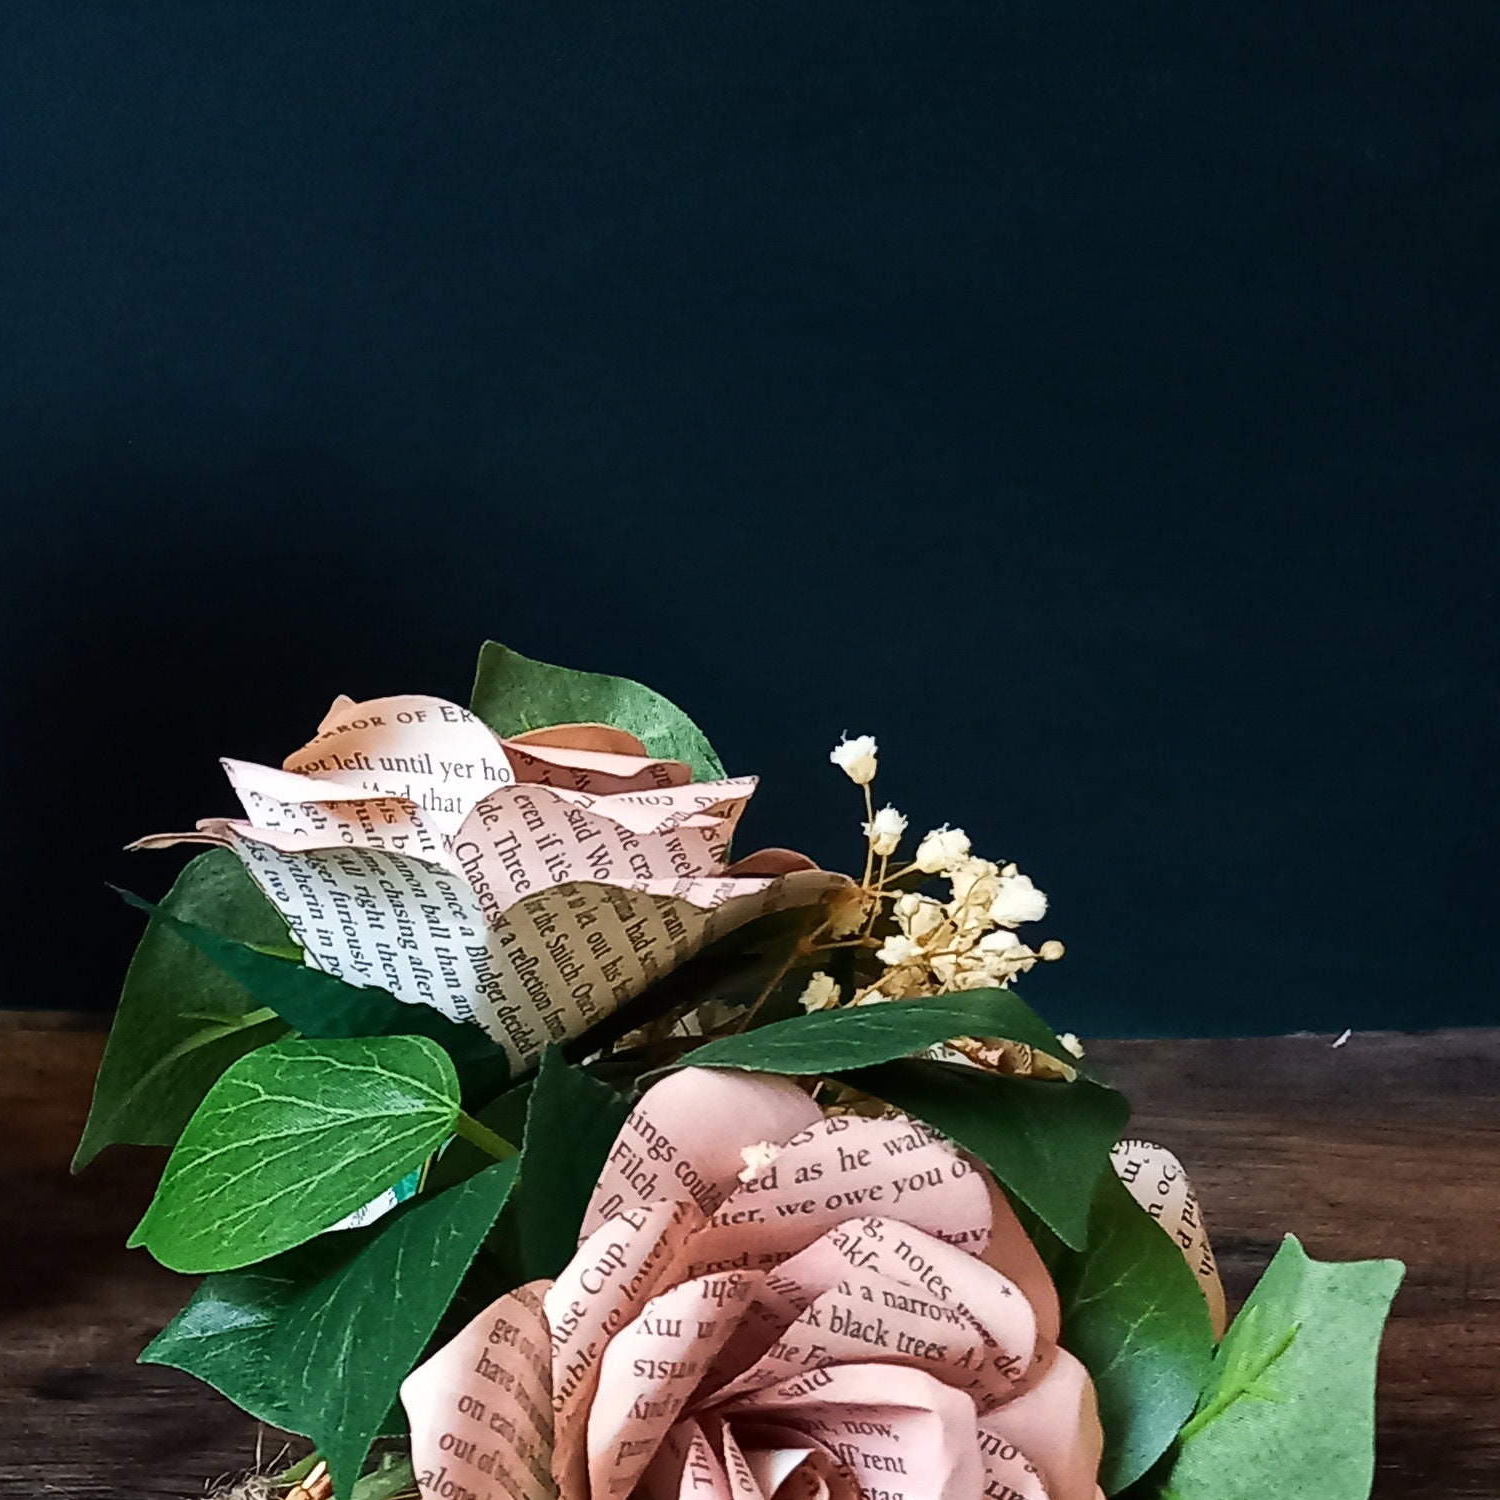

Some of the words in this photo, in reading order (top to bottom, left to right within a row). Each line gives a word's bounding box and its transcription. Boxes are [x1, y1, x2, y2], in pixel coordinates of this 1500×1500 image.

[397, 711, 427, 723] OF
[333, 752, 374, 771] left
[379, 753, 434, 775] until
[439, 759, 475, 783] yer
[422, 788, 463, 814] that
[514, 794, 545, 832] even
[536, 833, 564, 851] if
[564, 809, 602, 843] said
[493, 829, 531, 894] Three
[545, 852, 573, 883] it's
[354, 884, 386, 930] right
[436, 880, 468, 921] once
[316, 928, 334, 948] in
[329, 888, 373, 978] furiously
[379, 879, 418, 951] chasing
[408, 954, 435, 1001] after
[420, 903, 451, 940] ball
[459, 925, 475, 938] a
[434, 946, 461, 989] than
[465, 945, 506, 1004] Bludger
[794, 1162, 823, 1184] as
[838, 1146, 872, 1172] he
[776, 1198, 816, 1218] we
[825, 1182, 884, 1210] owe
[891, 1167, 944, 1204] you
[580, 1242, 630, 1296] Cup.
[894, 1239, 952, 1301] notes
[859, 1284, 874, 1303] a
[601, 1308, 620, 1336] to
[828, 1305, 891, 1346] black
[897, 1331, 950, 1362] trees
[458, 1396, 485, 1421] on
[440, 1434, 477, 1464] out
